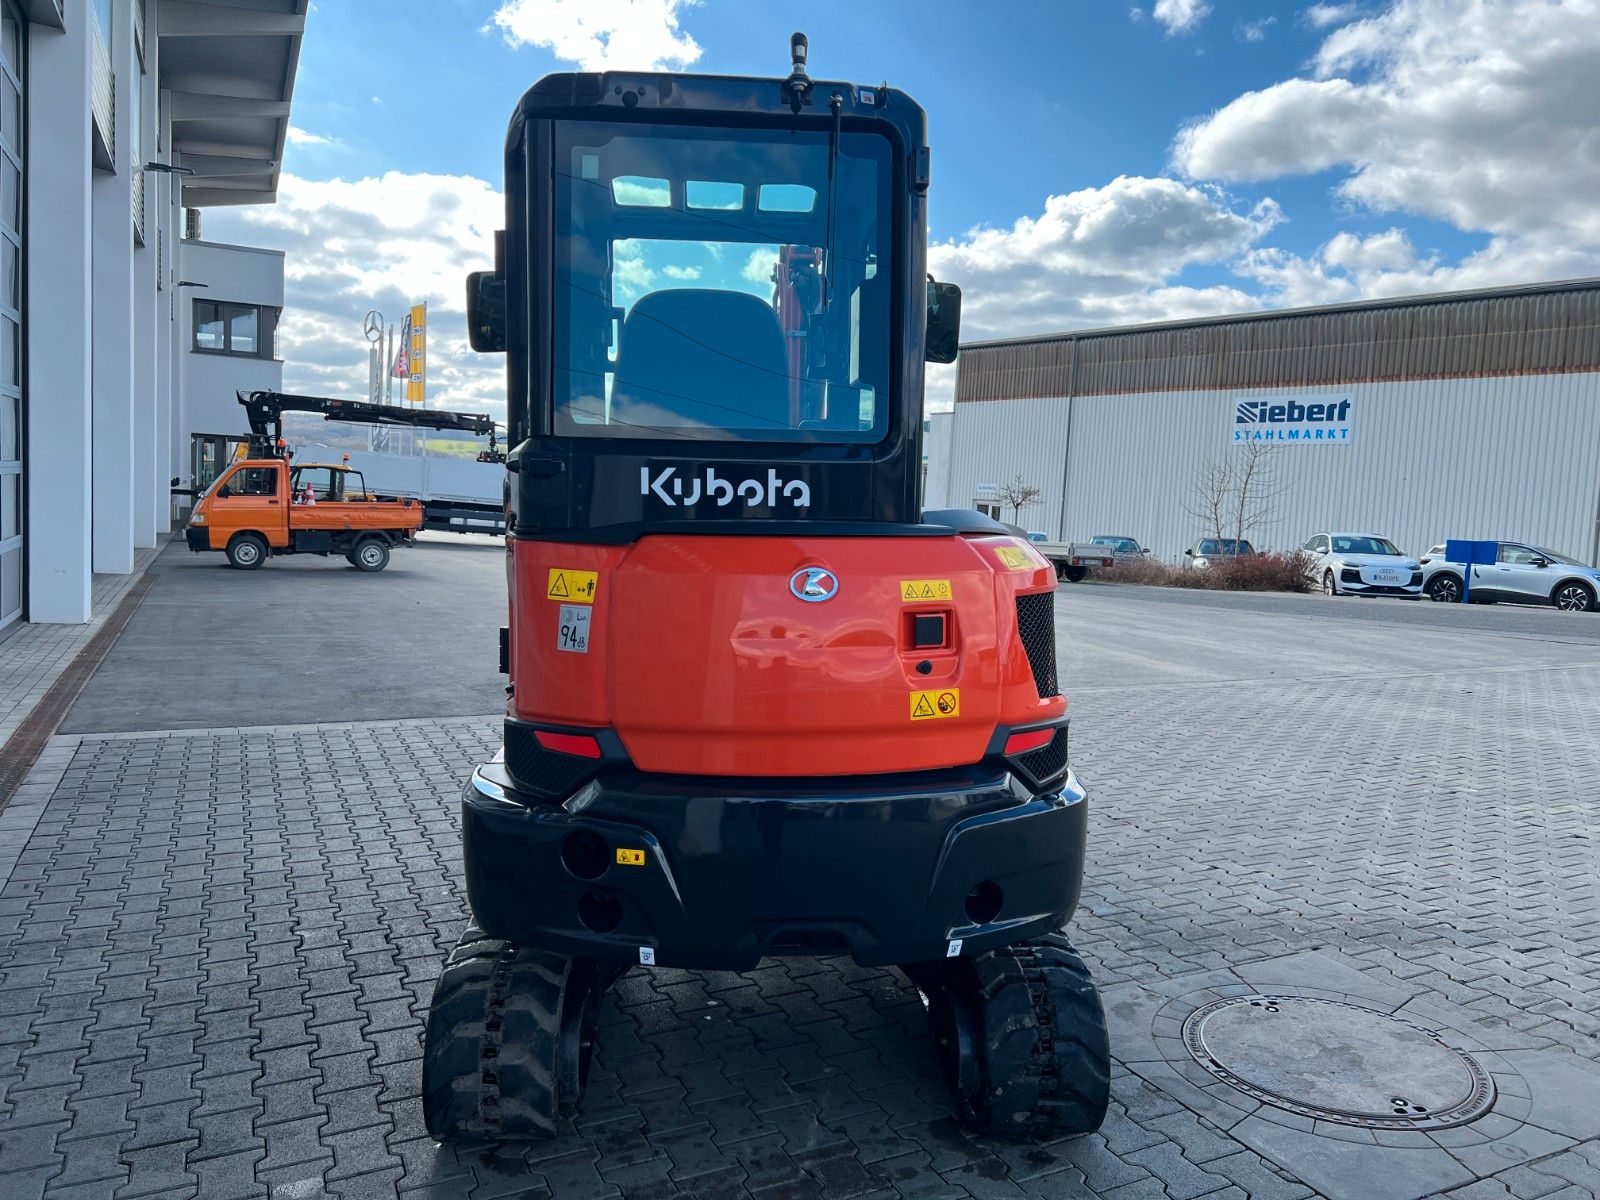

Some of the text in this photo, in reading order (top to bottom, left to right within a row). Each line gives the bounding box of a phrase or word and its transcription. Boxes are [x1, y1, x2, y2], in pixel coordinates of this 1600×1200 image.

[1236, 399, 1350, 423] Siebert
[1234, 428, 1348, 440] STAHLMARKT
[640, 466, 811, 507] Kubota
